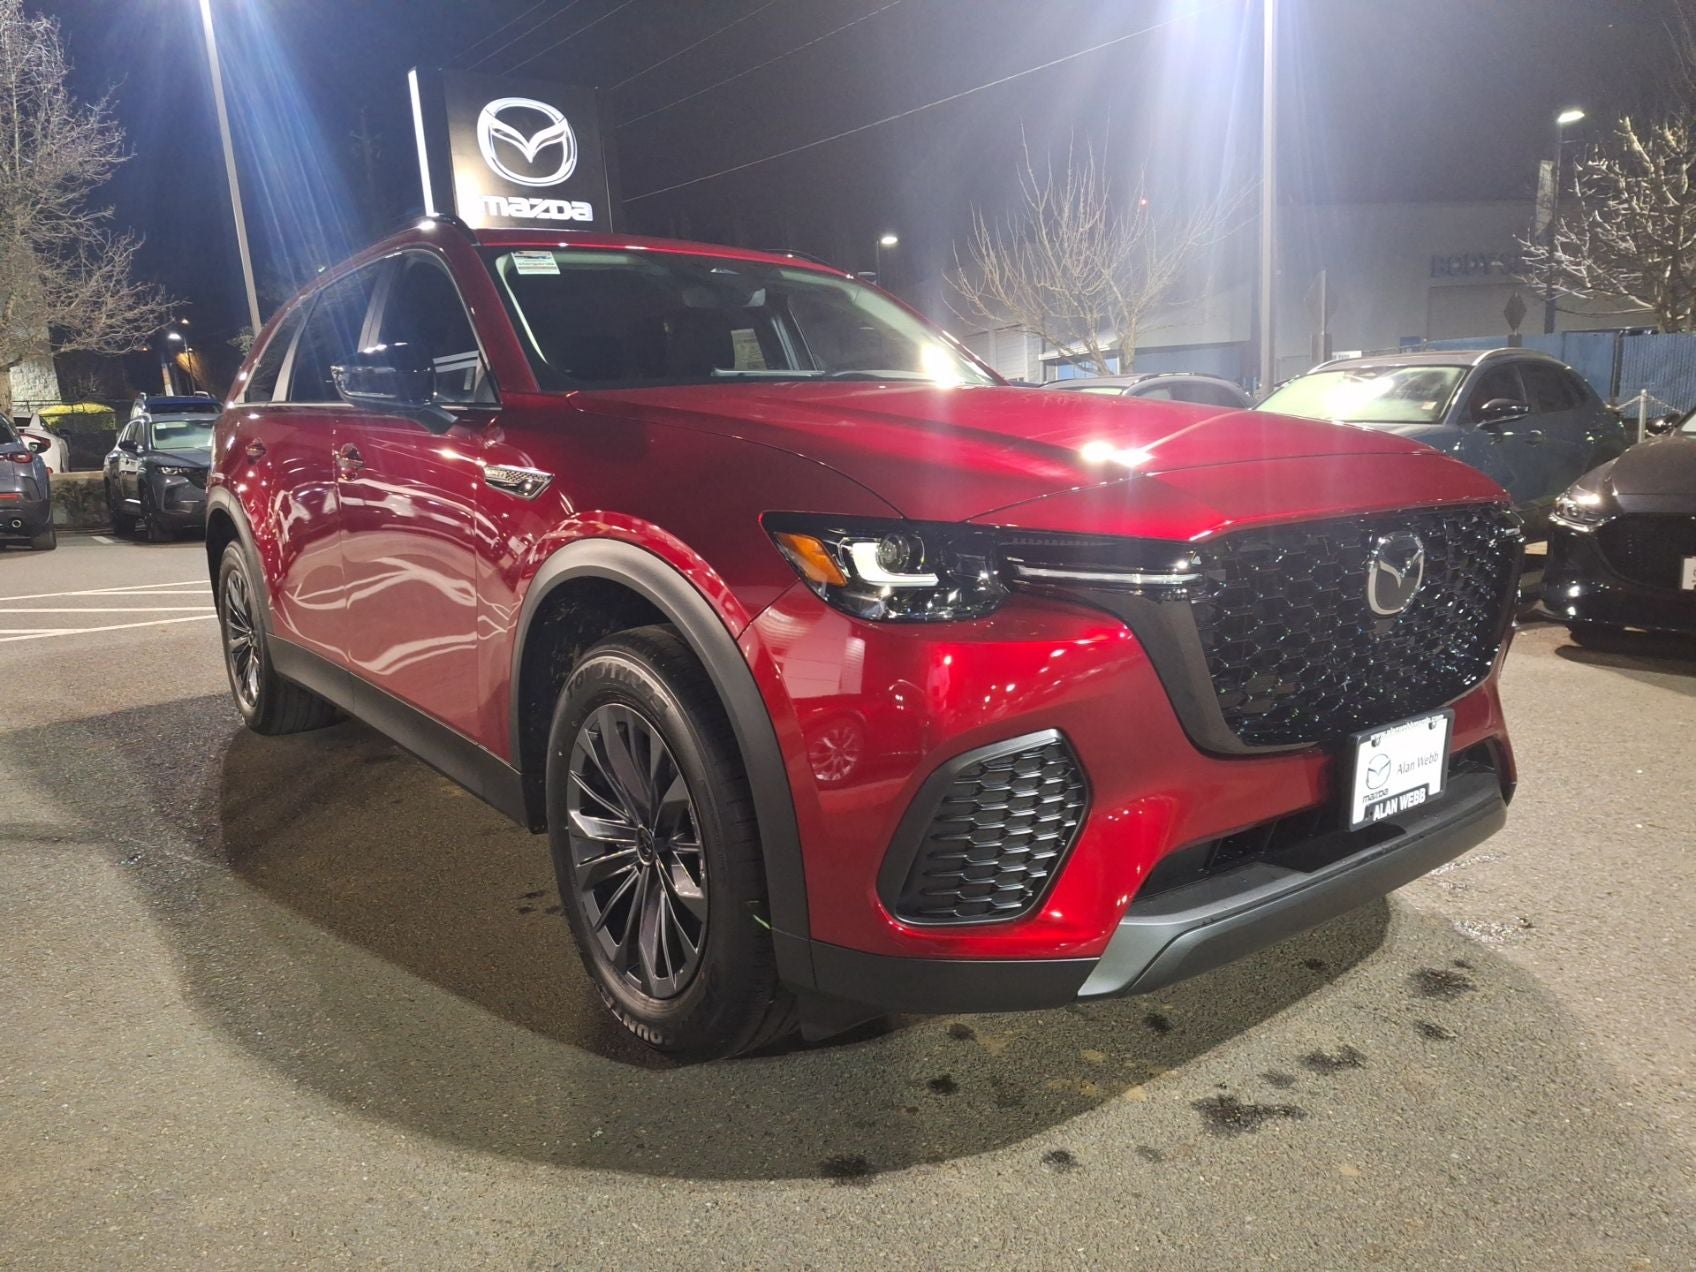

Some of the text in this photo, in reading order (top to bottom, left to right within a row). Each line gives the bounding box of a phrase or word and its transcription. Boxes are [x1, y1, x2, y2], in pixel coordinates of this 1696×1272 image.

[1397, 752, 1439, 775] Alan Webb
[1373, 788, 1426, 821] ALAN WEBB
